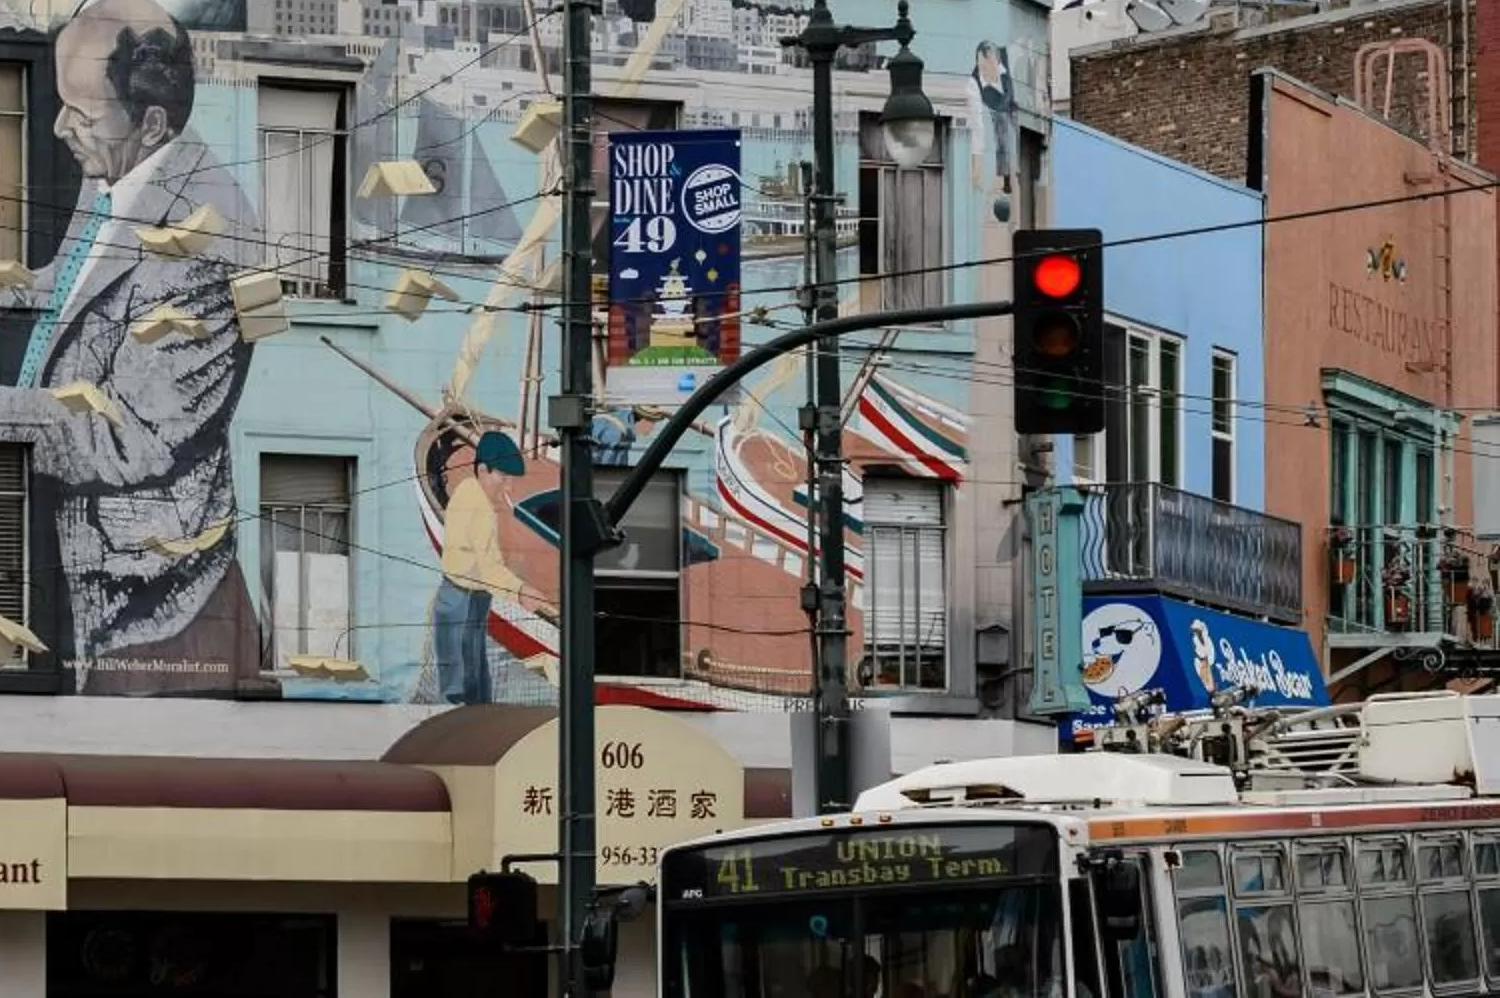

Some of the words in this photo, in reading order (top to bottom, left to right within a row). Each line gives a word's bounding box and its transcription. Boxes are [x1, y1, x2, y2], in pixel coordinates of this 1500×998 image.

[614, 142, 675, 178] SHOP
[614, 178, 675, 215] DINE
[694, 193, 739, 216] SMALL
[695, 183, 731, 203] SHOP
[613, 215, 677, 253] 49
[1039, 504, 1055, 703] HOTEL
[601, 742, 644, 769] 606
[717, 849, 759, 893] 41
[837, 833, 941, 862] UNION
[780, 861, 911, 890] Transbay
[927, 856, 1008, 878] Term.
